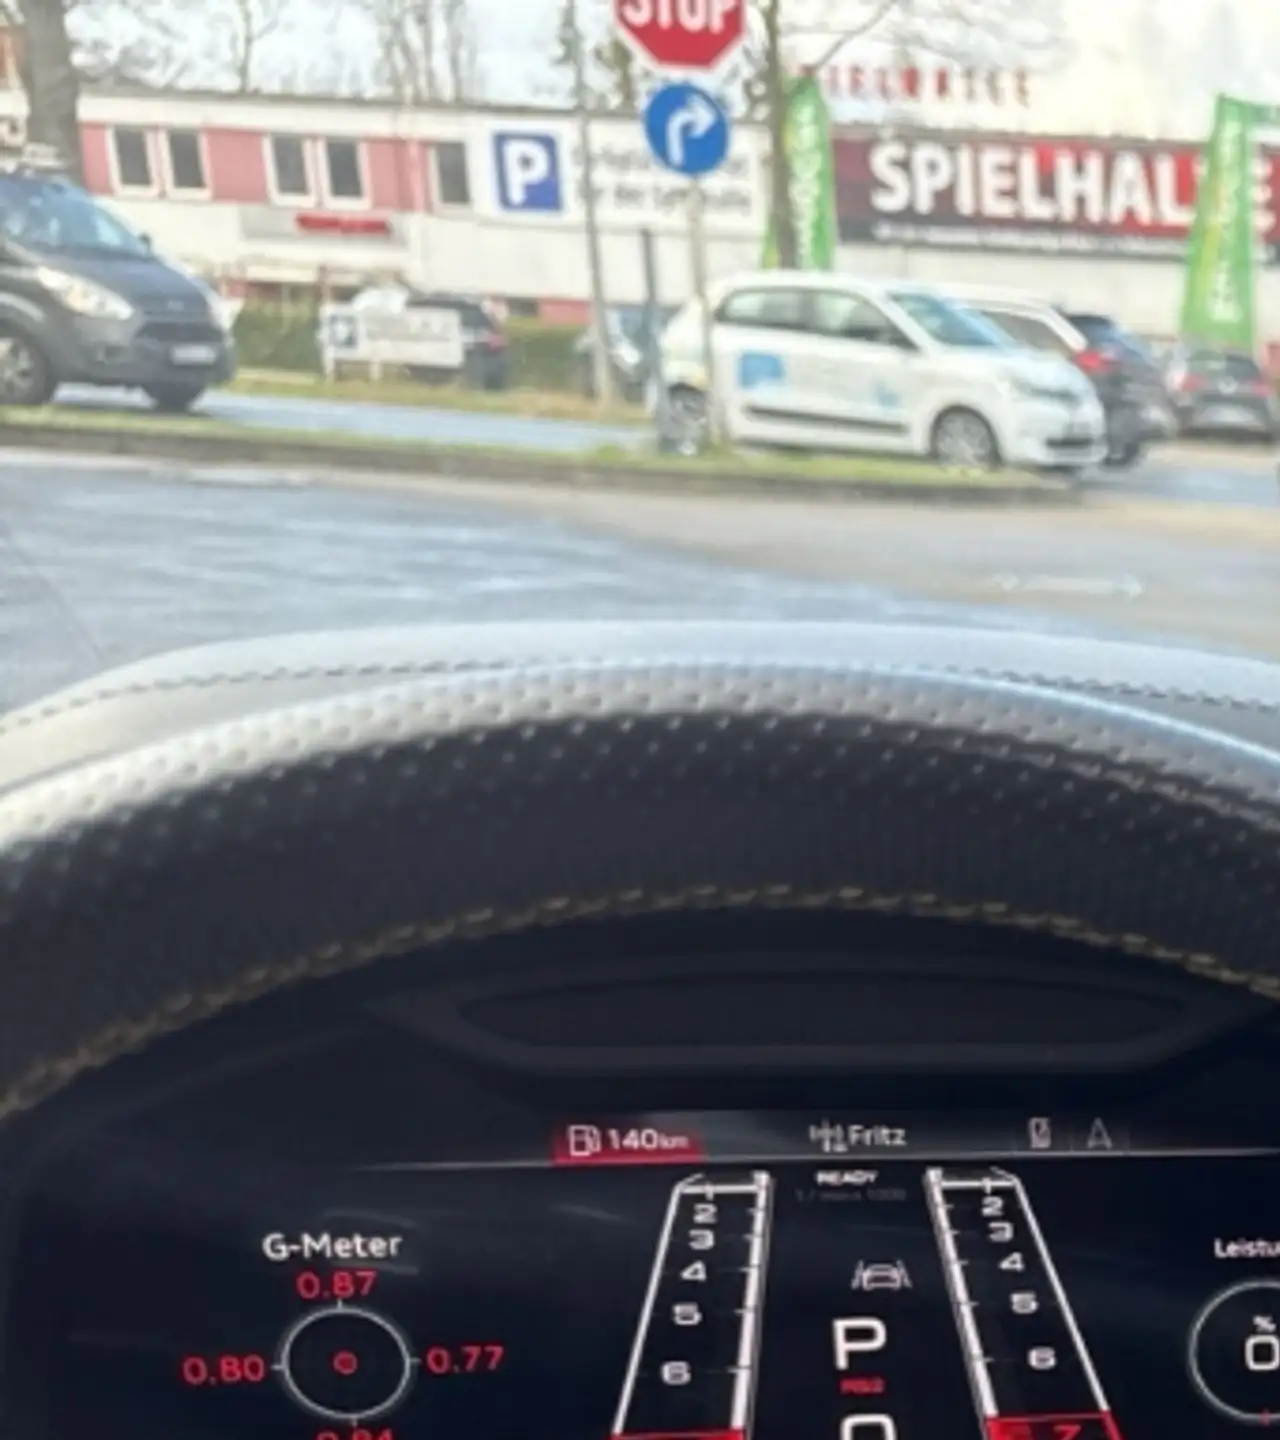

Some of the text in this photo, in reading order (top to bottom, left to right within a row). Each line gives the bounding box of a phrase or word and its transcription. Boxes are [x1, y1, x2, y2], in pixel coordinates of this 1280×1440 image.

[502, 138, 551, 206] P
[847, 1124, 907, 1147] Fritz
[687, 1228, 716, 1252] 3
[987, 1221, 1015, 1243] 3
[262, 1232, 404, 1262] G-Meter
[679, 1259, 708, 1282] 4
[997, 1251, 1026, 1273] 4
[296, 1269, 377, 1300] 0.87
[672, 1301, 702, 1326] 5
[1009, 1290, 1040, 1315] 5
[832, 1316, 887, 1370] P
[181, 1355, 266, 1385] 0.80
[425, 1344, 504, 1375] 0.77
[1027, 1345, 1057, 1371] 6
[660, 1360, 691, 1386] 6
